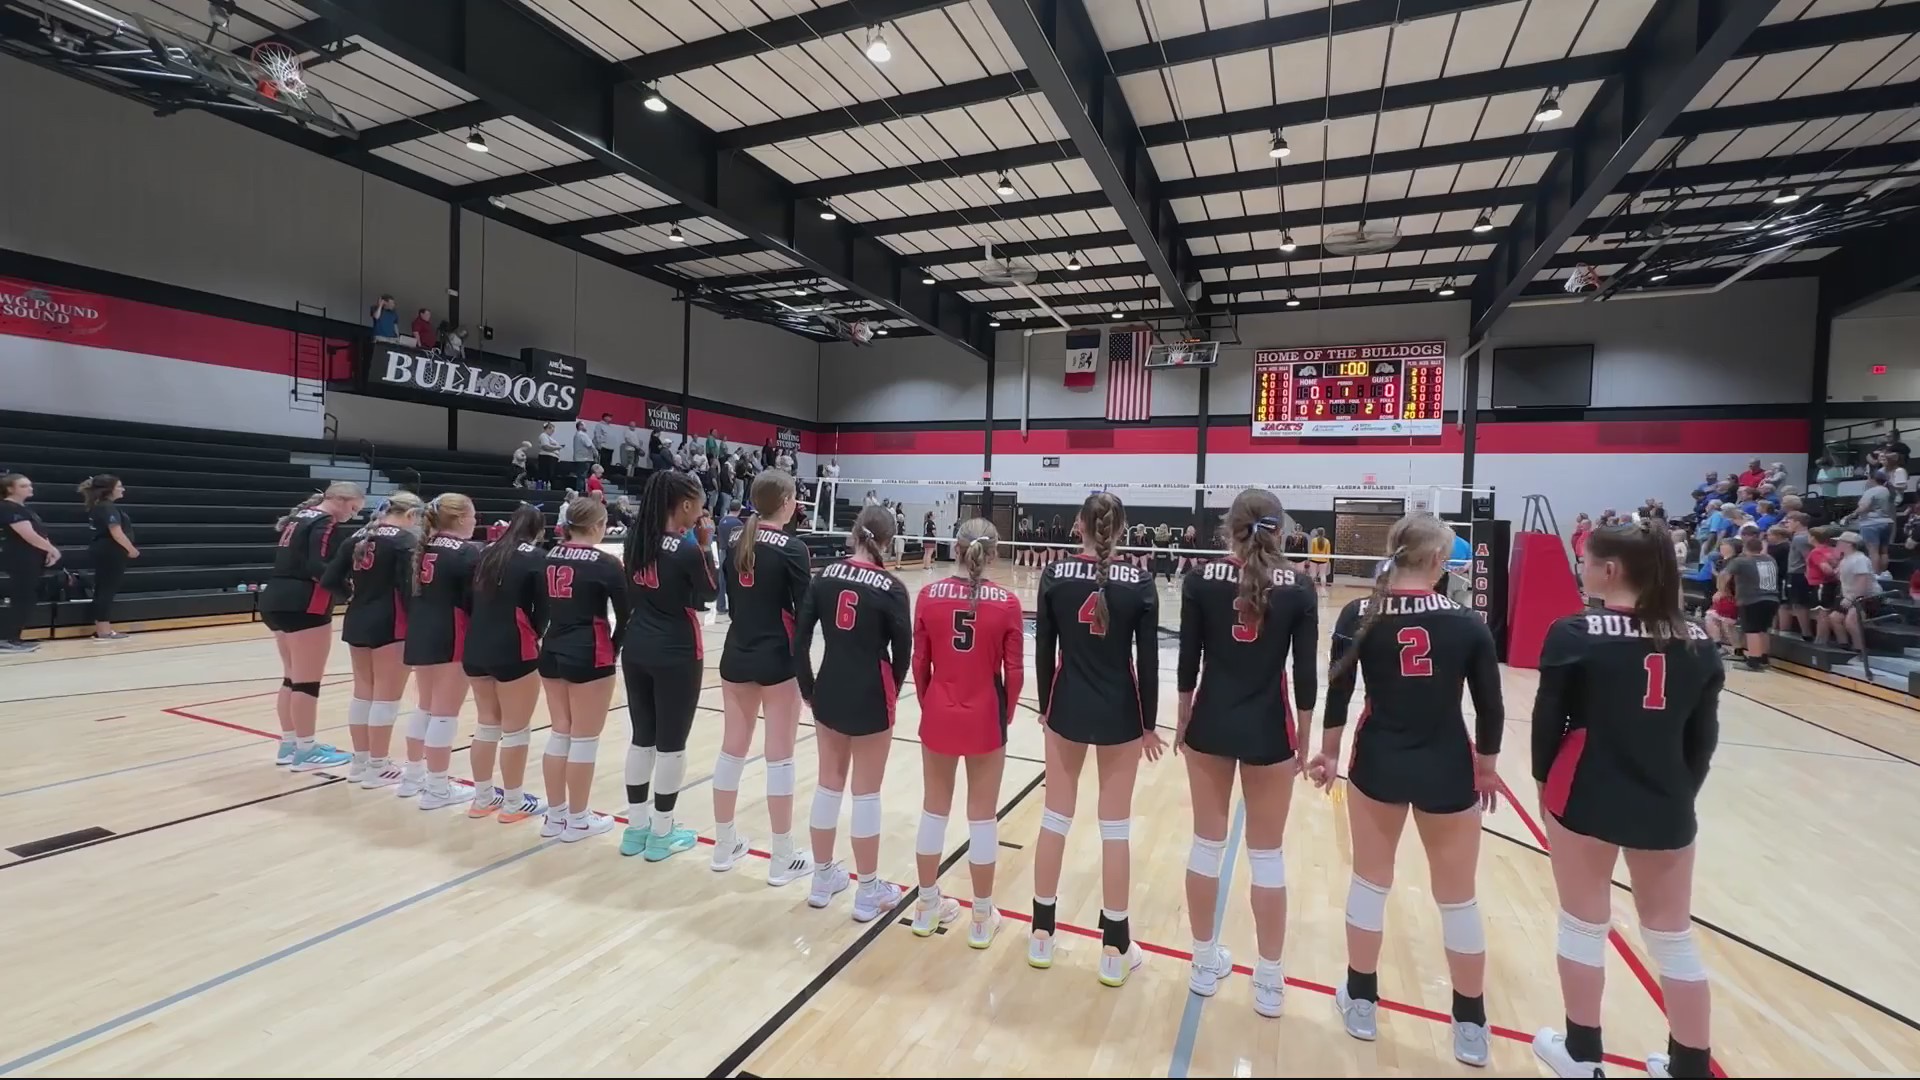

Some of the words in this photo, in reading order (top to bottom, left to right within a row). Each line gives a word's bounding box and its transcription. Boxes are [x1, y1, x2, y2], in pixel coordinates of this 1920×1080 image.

[2, 304, 70, 324] SOUND
[34, 299, 99, 319] POUND
[1258, 351, 1300, 363] HOME
[1303, 350, 1323, 361] OF
[1327, 348, 1357, 360] THE
[1361, 344, 1442, 359] BULLDOGS
[1339, 361, 1367, 376] 1:00
[1420, 367, 1427, 376] 0
[1435, 367, 1442, 375] 0
[381, 350, 577, 412] BULLDOGS
[1283, 372, 1289, 380] 0
[1299, 378, 1318, 386] HOME
[1371, 376, 1394, 384] GUEST
[1420, 376, 1427, 384] 0
[1435, 376, 1442, 384] 0
[1269, 389, 1275, 397] 0
[1310, 386, 1320, 399] 0
[1384, 383, 1394, 397] 0
[1419, 385, 1426, 393] 0
[1434, 384, 1441, 393] 0
[1269, 397, 1275, 405] 0
[1419, 393, 1426, 402] 0
[1434, 393, 1441, 401] 0
[1281, 405, 1287, 413] 0
[1300, 405, 1308, 415] 0
[1315, 404, 1324, 415] 2
[1365, 403, 1374, 414] 2
[1385, 403, 1393, 414] 0
[1419, 402, 1425, 410] 0
[1433, 402, 1440, 410] 0
[648, 408, 681, 422] VISITING
[1281, 413, 1287, 421] 0
[1403, 411, 1416, 419] 20
[1418, 411, 1425, 419] 0
[1433, 410, 1440, 418] 0
[650, 418, 679, 431] ADULTS
[821, 563, 893, 592] BULLDOGS
[1054, 561, 1141, 584] BULLOGS
[546, 565, 575, 598] 12
[835, 589, 859, 632] 6
[1078, 591, 1107, 636] 4
[1232, 596, 1259, 642] 3
[951, 609, 977, 653] 5
[1396, 625, 1433, 676] 2
[1642, 653, 1667, 710] 1
